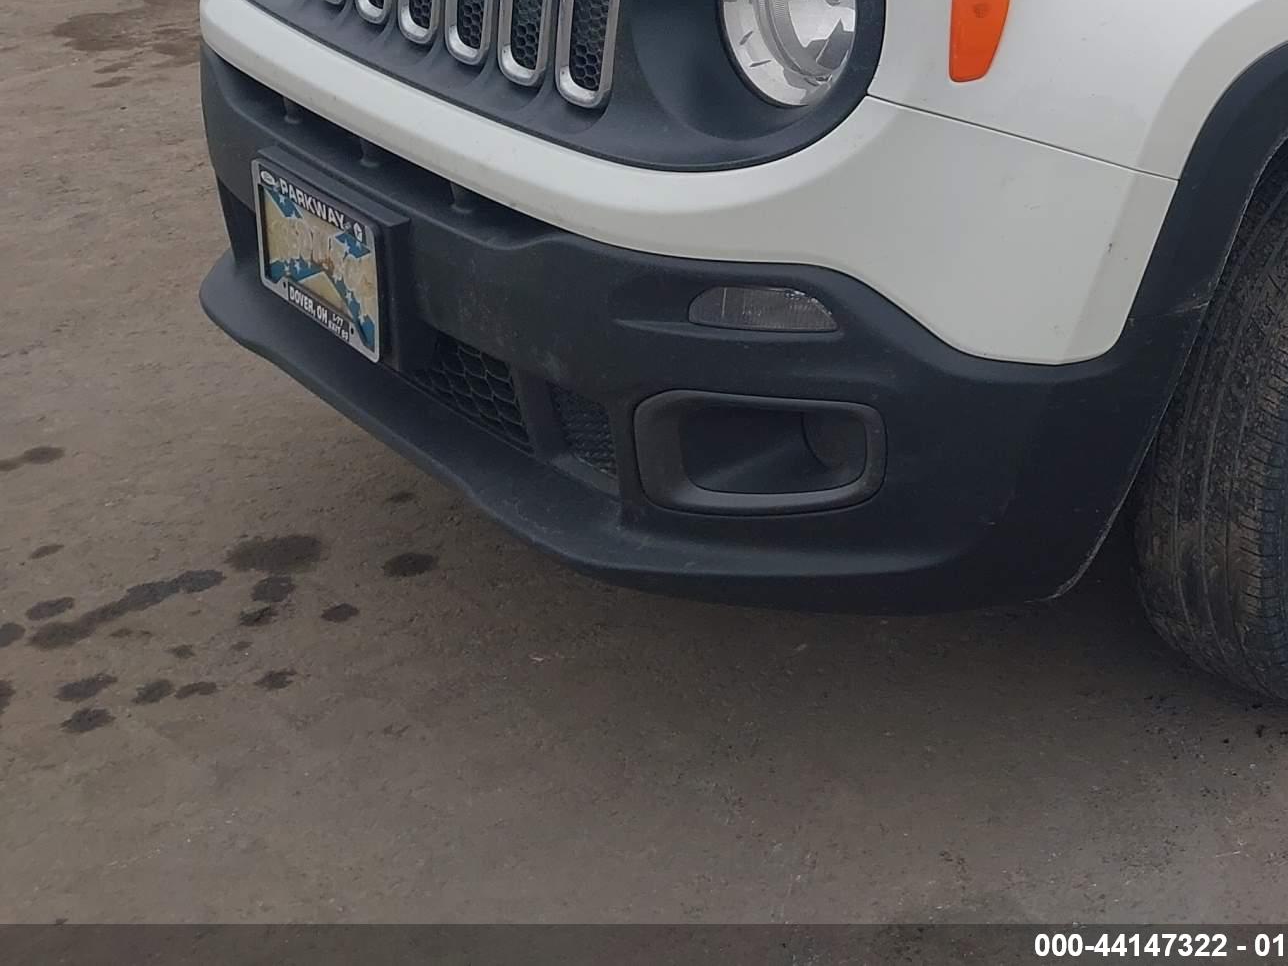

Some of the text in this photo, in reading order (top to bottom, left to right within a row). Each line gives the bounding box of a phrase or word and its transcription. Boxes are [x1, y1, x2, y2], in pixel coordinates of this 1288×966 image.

[279, 177, 345, 229] PARKWAY
[289, 286, 328, 324] DOVER, OH
